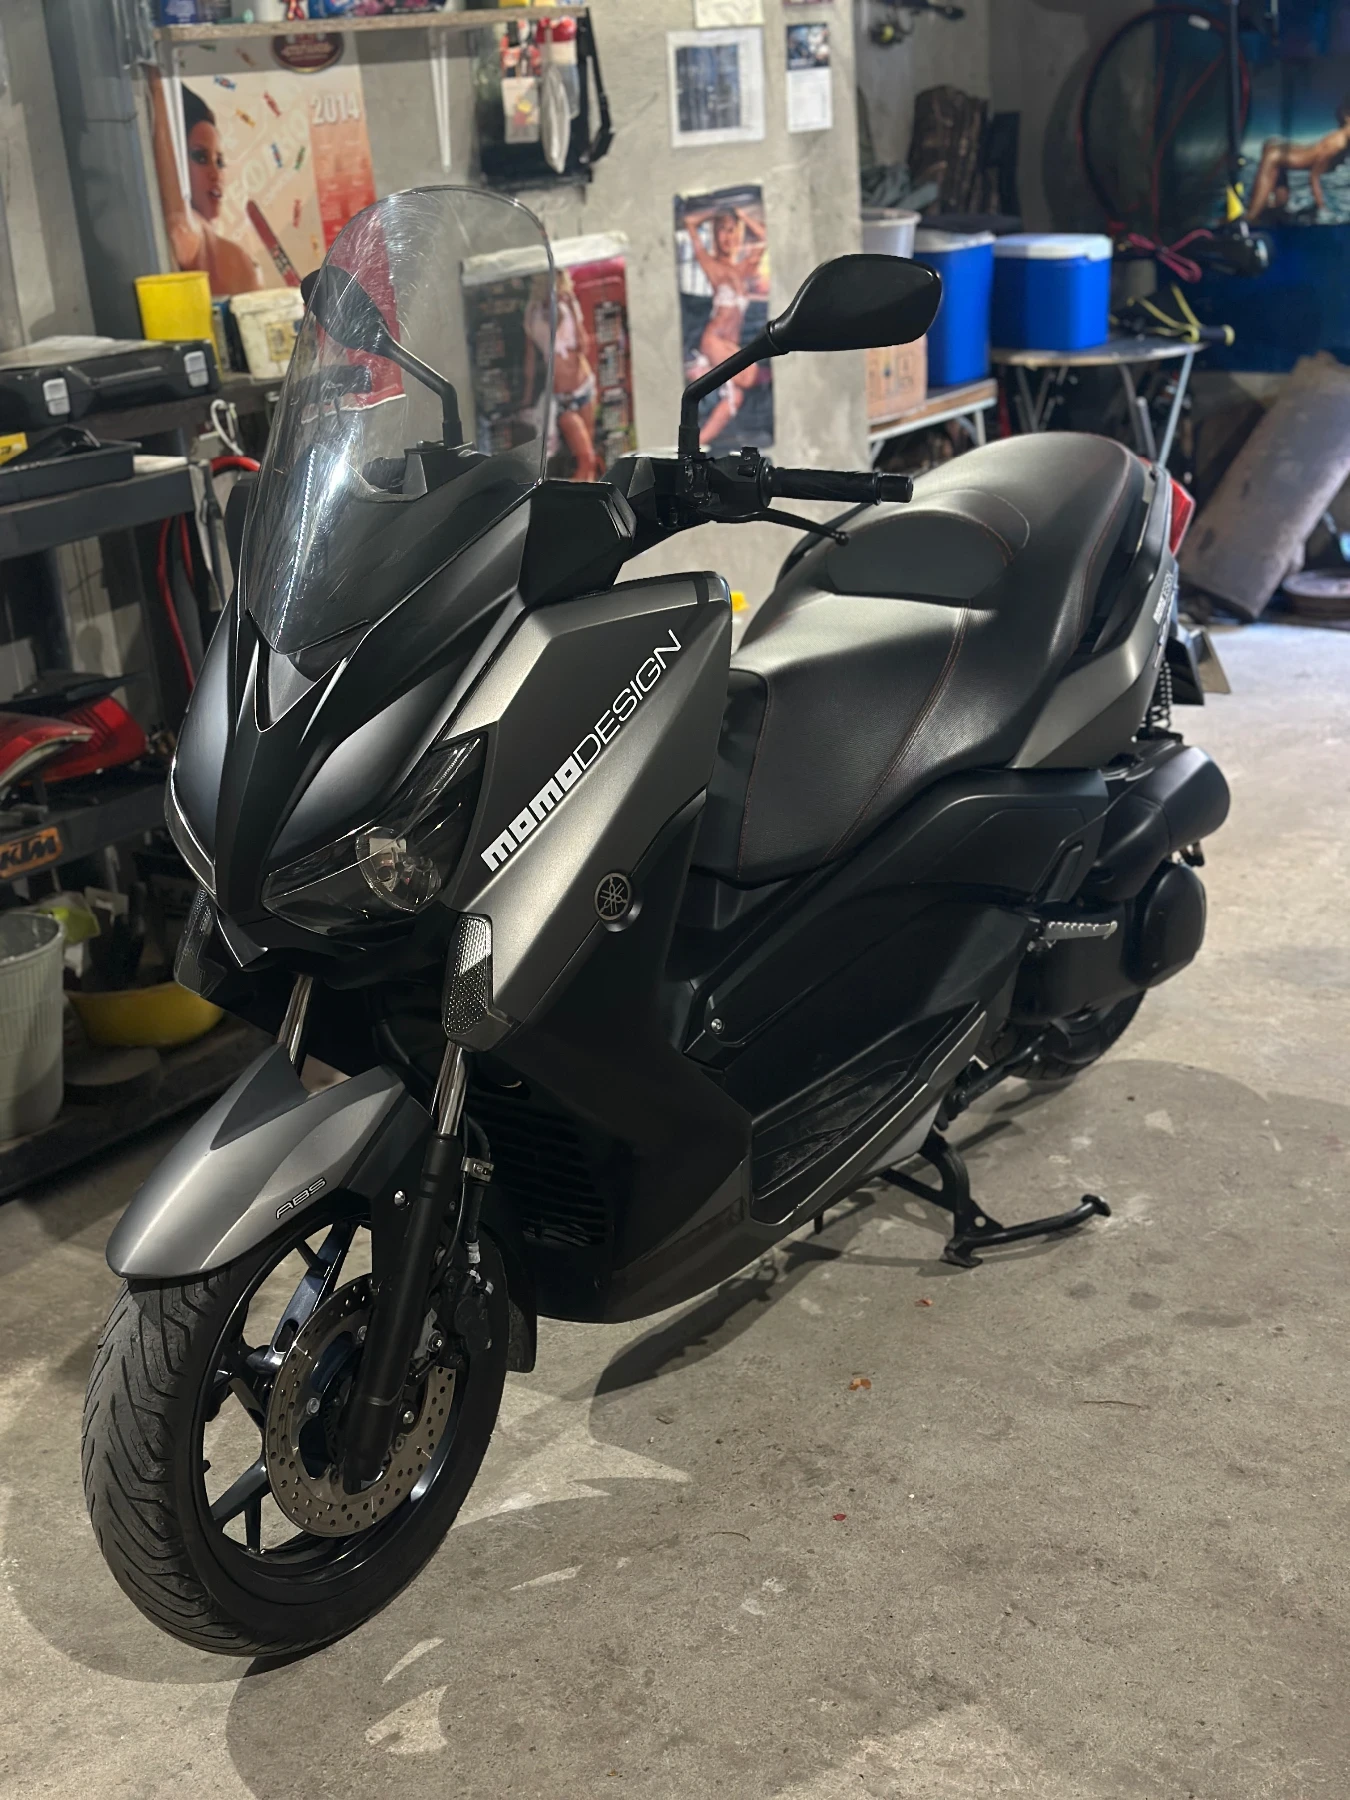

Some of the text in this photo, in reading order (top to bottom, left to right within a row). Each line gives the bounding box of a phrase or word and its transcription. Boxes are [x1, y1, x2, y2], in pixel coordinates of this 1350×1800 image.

[311, 91, 361, 126] 2014
[0, 835, 57, 871] KTM
[276, 1177, 326, 1219] ABS
